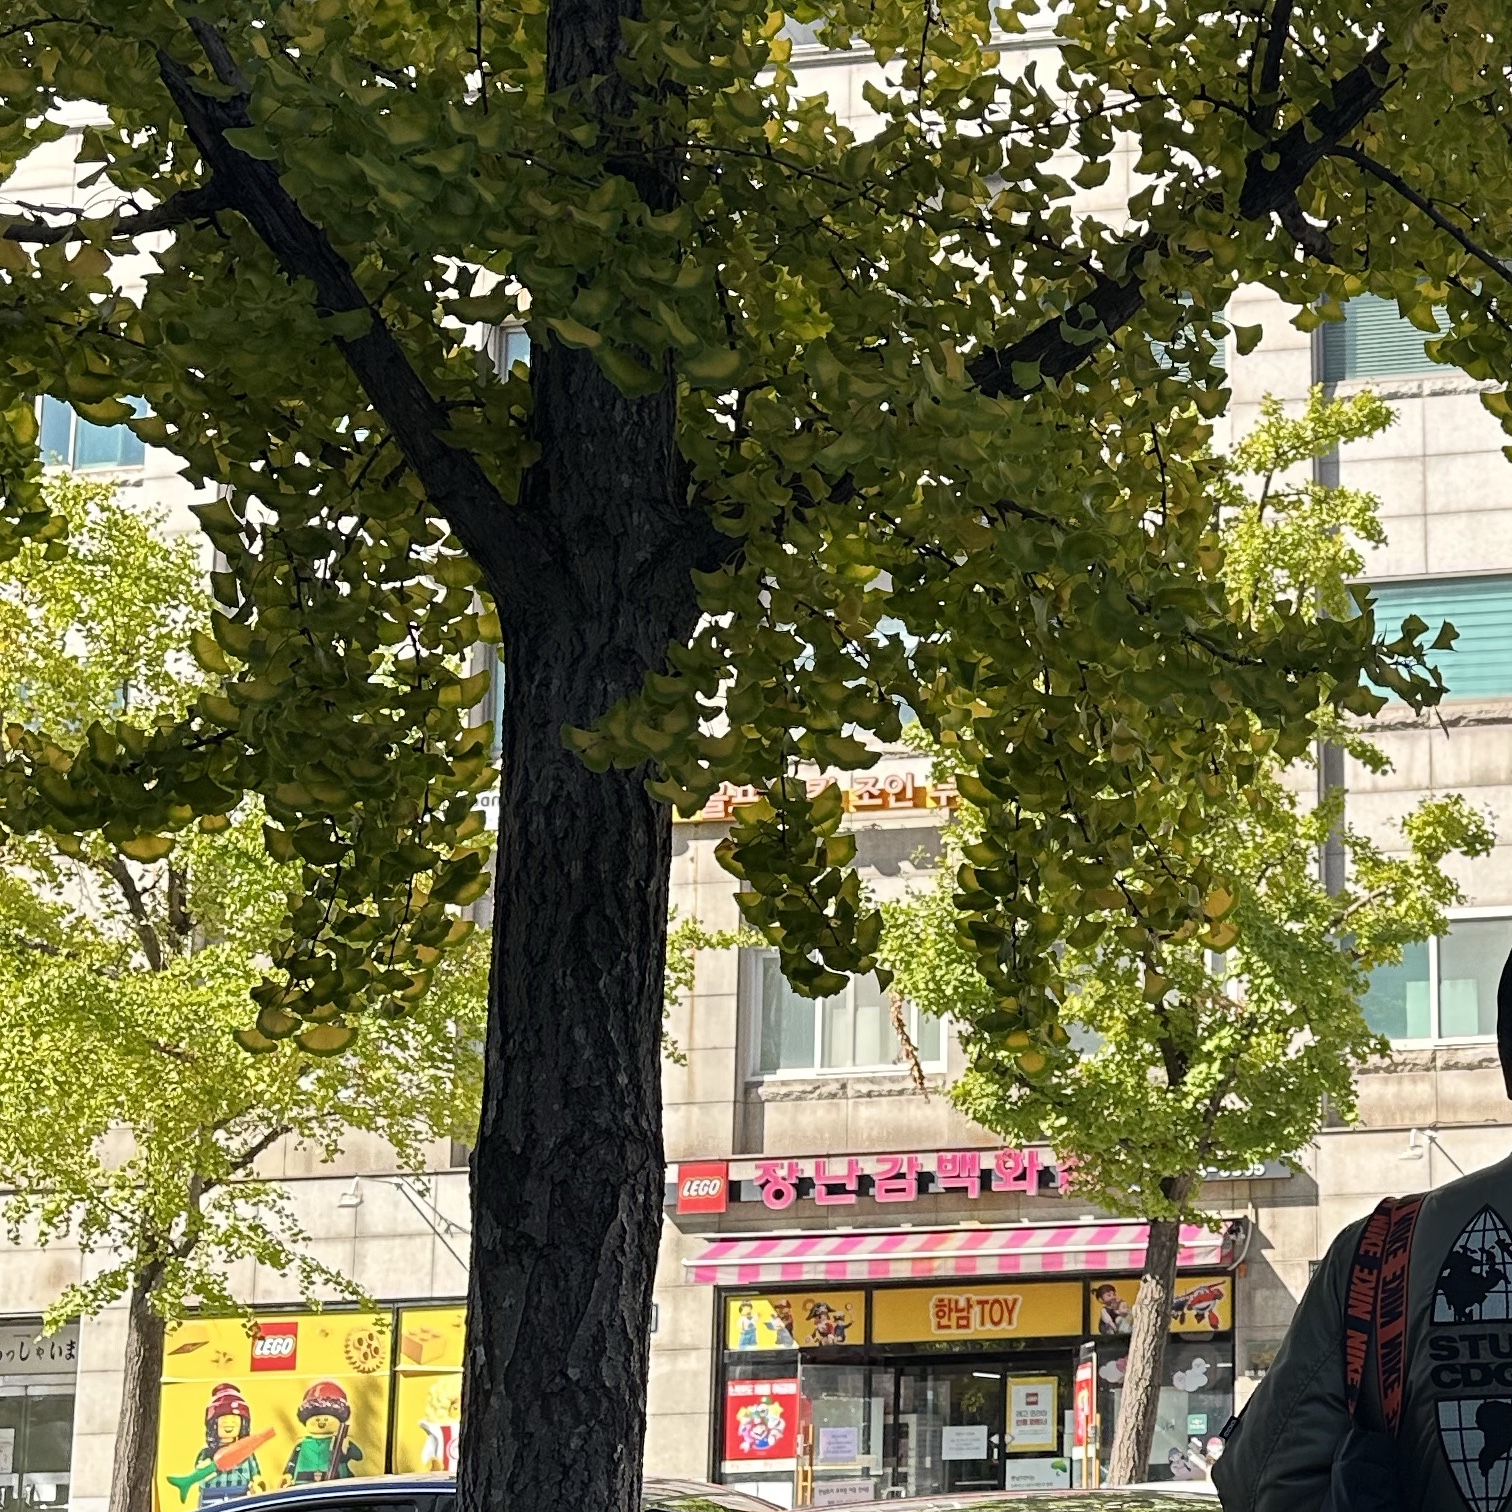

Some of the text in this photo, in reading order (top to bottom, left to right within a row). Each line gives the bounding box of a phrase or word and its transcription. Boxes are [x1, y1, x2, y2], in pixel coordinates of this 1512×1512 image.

[849, 772, 915, 808] 조인
[681, 1174, 723, 1198] LEGO
[753, 1149, 1074, 1210] 장난감백화
[1346, 1213, 1391, 1388] NIKE NIKE NIKE
[0, 1339, 77, 1362] っしゃいま
[254, 1336, 295, 1356] LEGO
